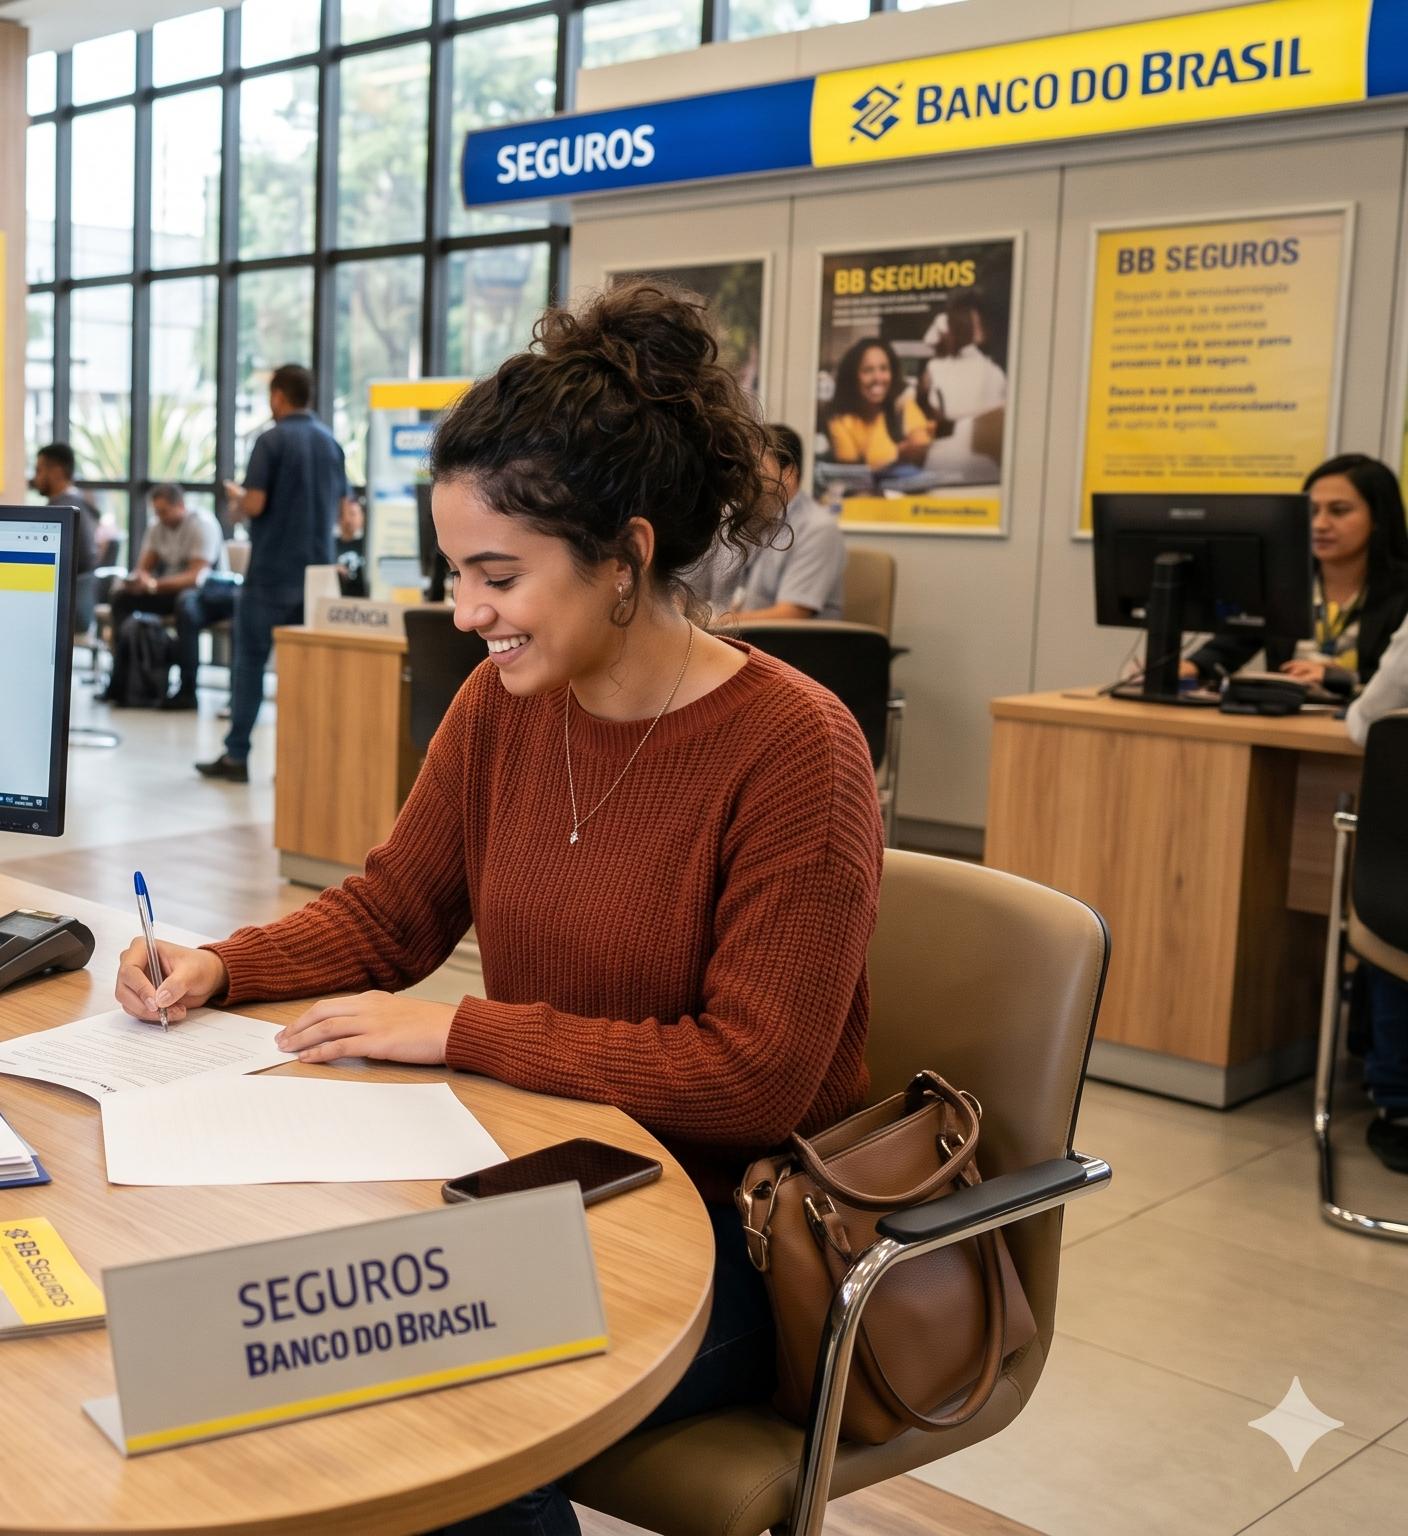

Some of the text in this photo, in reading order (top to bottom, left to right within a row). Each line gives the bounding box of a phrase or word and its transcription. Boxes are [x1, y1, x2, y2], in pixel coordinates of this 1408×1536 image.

[916, 38, 1311, 125] BANCO DO BRASIL
[497, 124, 655, 184] SEGUROS
[833, 259, 976, 295] BB SEGUROS
[1116, 237, 1300, 276] BB SEGUROS
[328, 605, 388, 627] GERÊNCIA
[238, 1247, 450, 1328] SEGUROS
[245, 1301, 497, 1378] BANCO DO BRASIL
